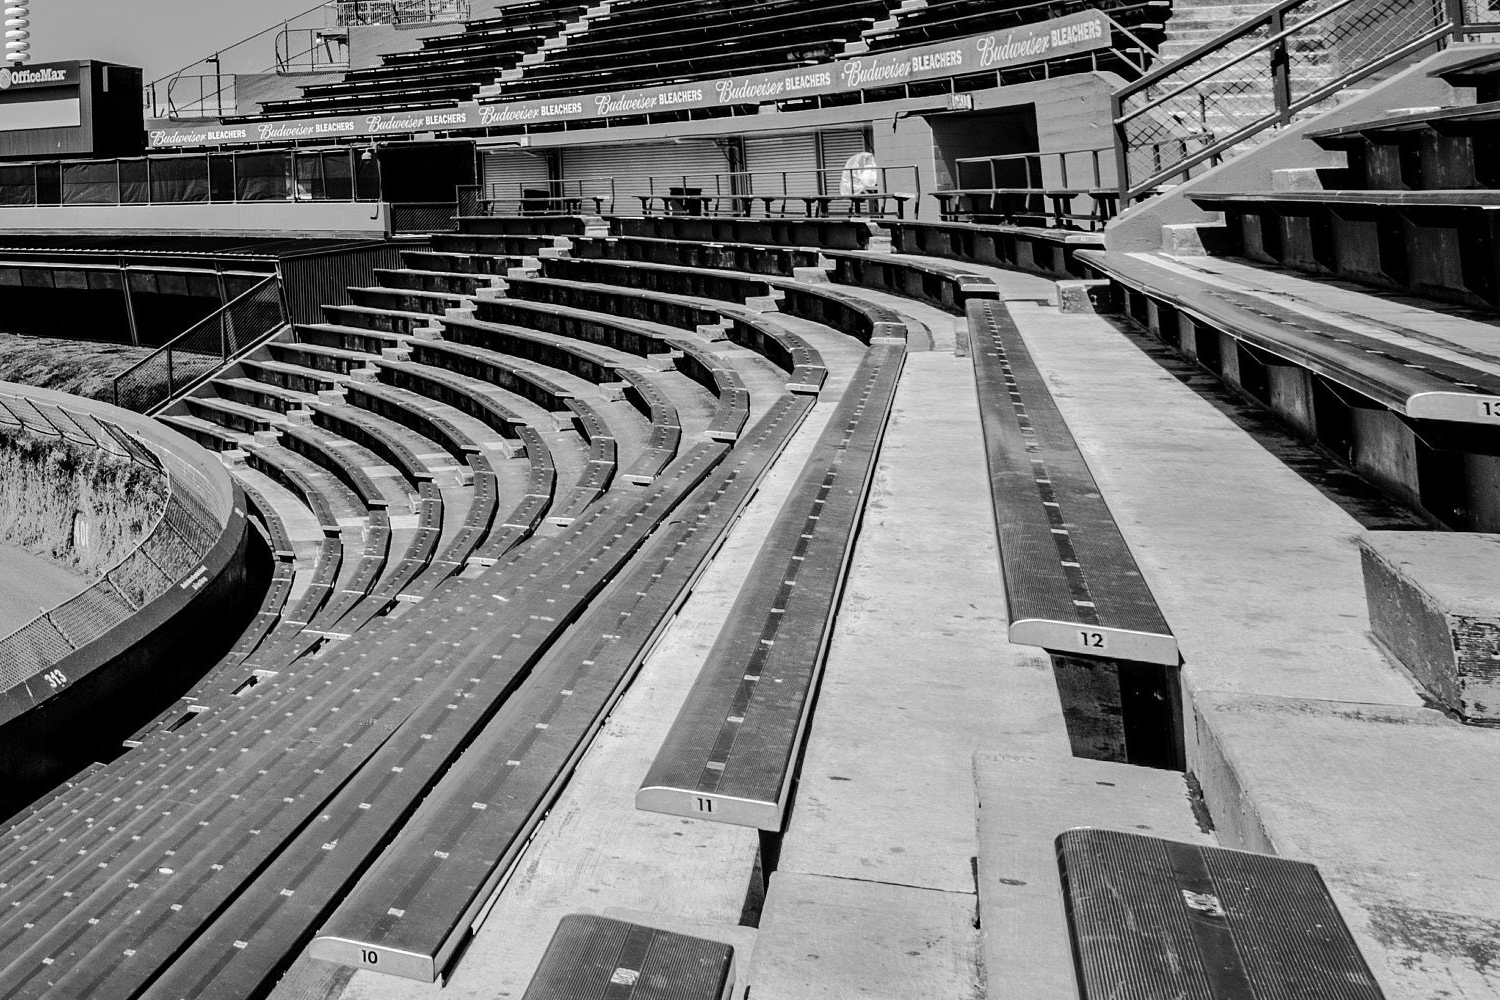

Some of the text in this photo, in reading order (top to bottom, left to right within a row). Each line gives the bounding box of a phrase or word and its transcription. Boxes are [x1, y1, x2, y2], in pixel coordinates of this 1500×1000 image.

[11, 68, 66, 84] OfficeMax
[150, 19, 1101, 146] Budweiser BLEACHERS Budweiser BLEACHERS Budweiser BLEACHERS Budweiser BLEACHERS Budweiser BLEACHERS Budweiser BLEACHERS Budweiser BLEACHERS Budweiser BLEACHERS
[1080, 632, 1103, 648] 12
[44, 668, 67, 689] 313
[697, 798, 712, 812] 11
[361, 949, 378, 964] 10
